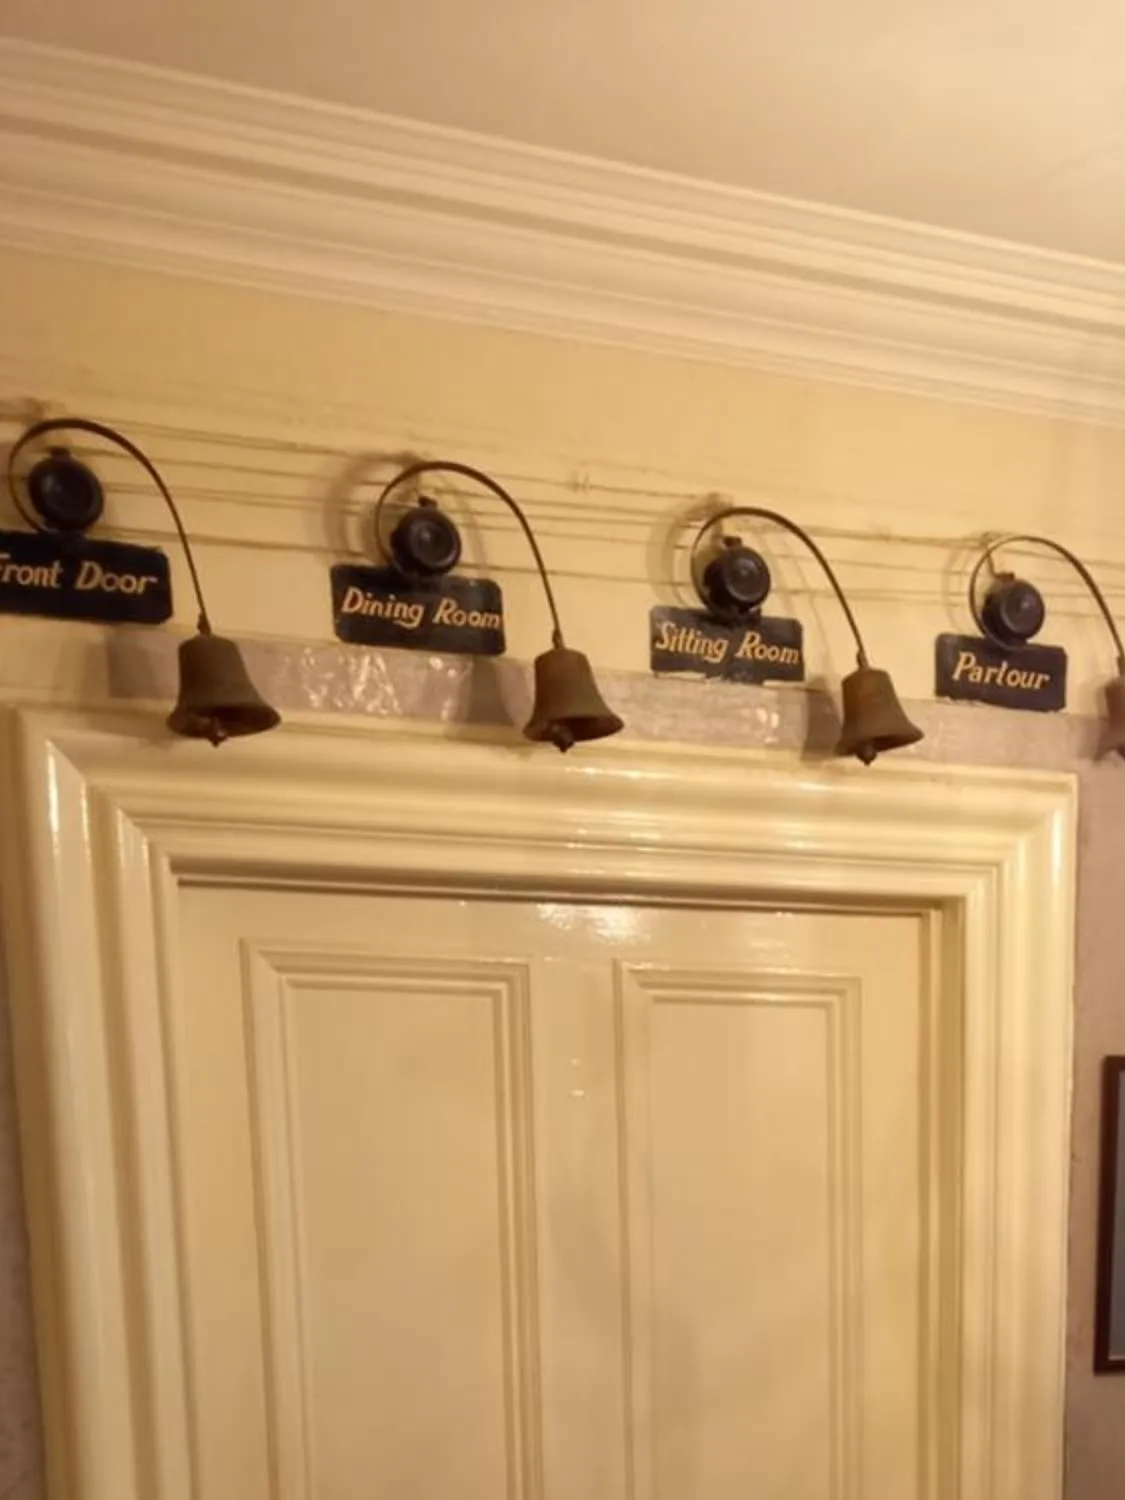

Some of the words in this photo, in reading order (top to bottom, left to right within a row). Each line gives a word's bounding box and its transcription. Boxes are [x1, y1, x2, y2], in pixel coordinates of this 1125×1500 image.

[75, 560, 158, 594] Door
[341, 586, 425, 627] Dining
[432, 600, 499, 629] Room
[655, 622, 728, 662] Sitting
[735, 634, 800, 665] Room
[951, 651, 1050, 690] Parlour
